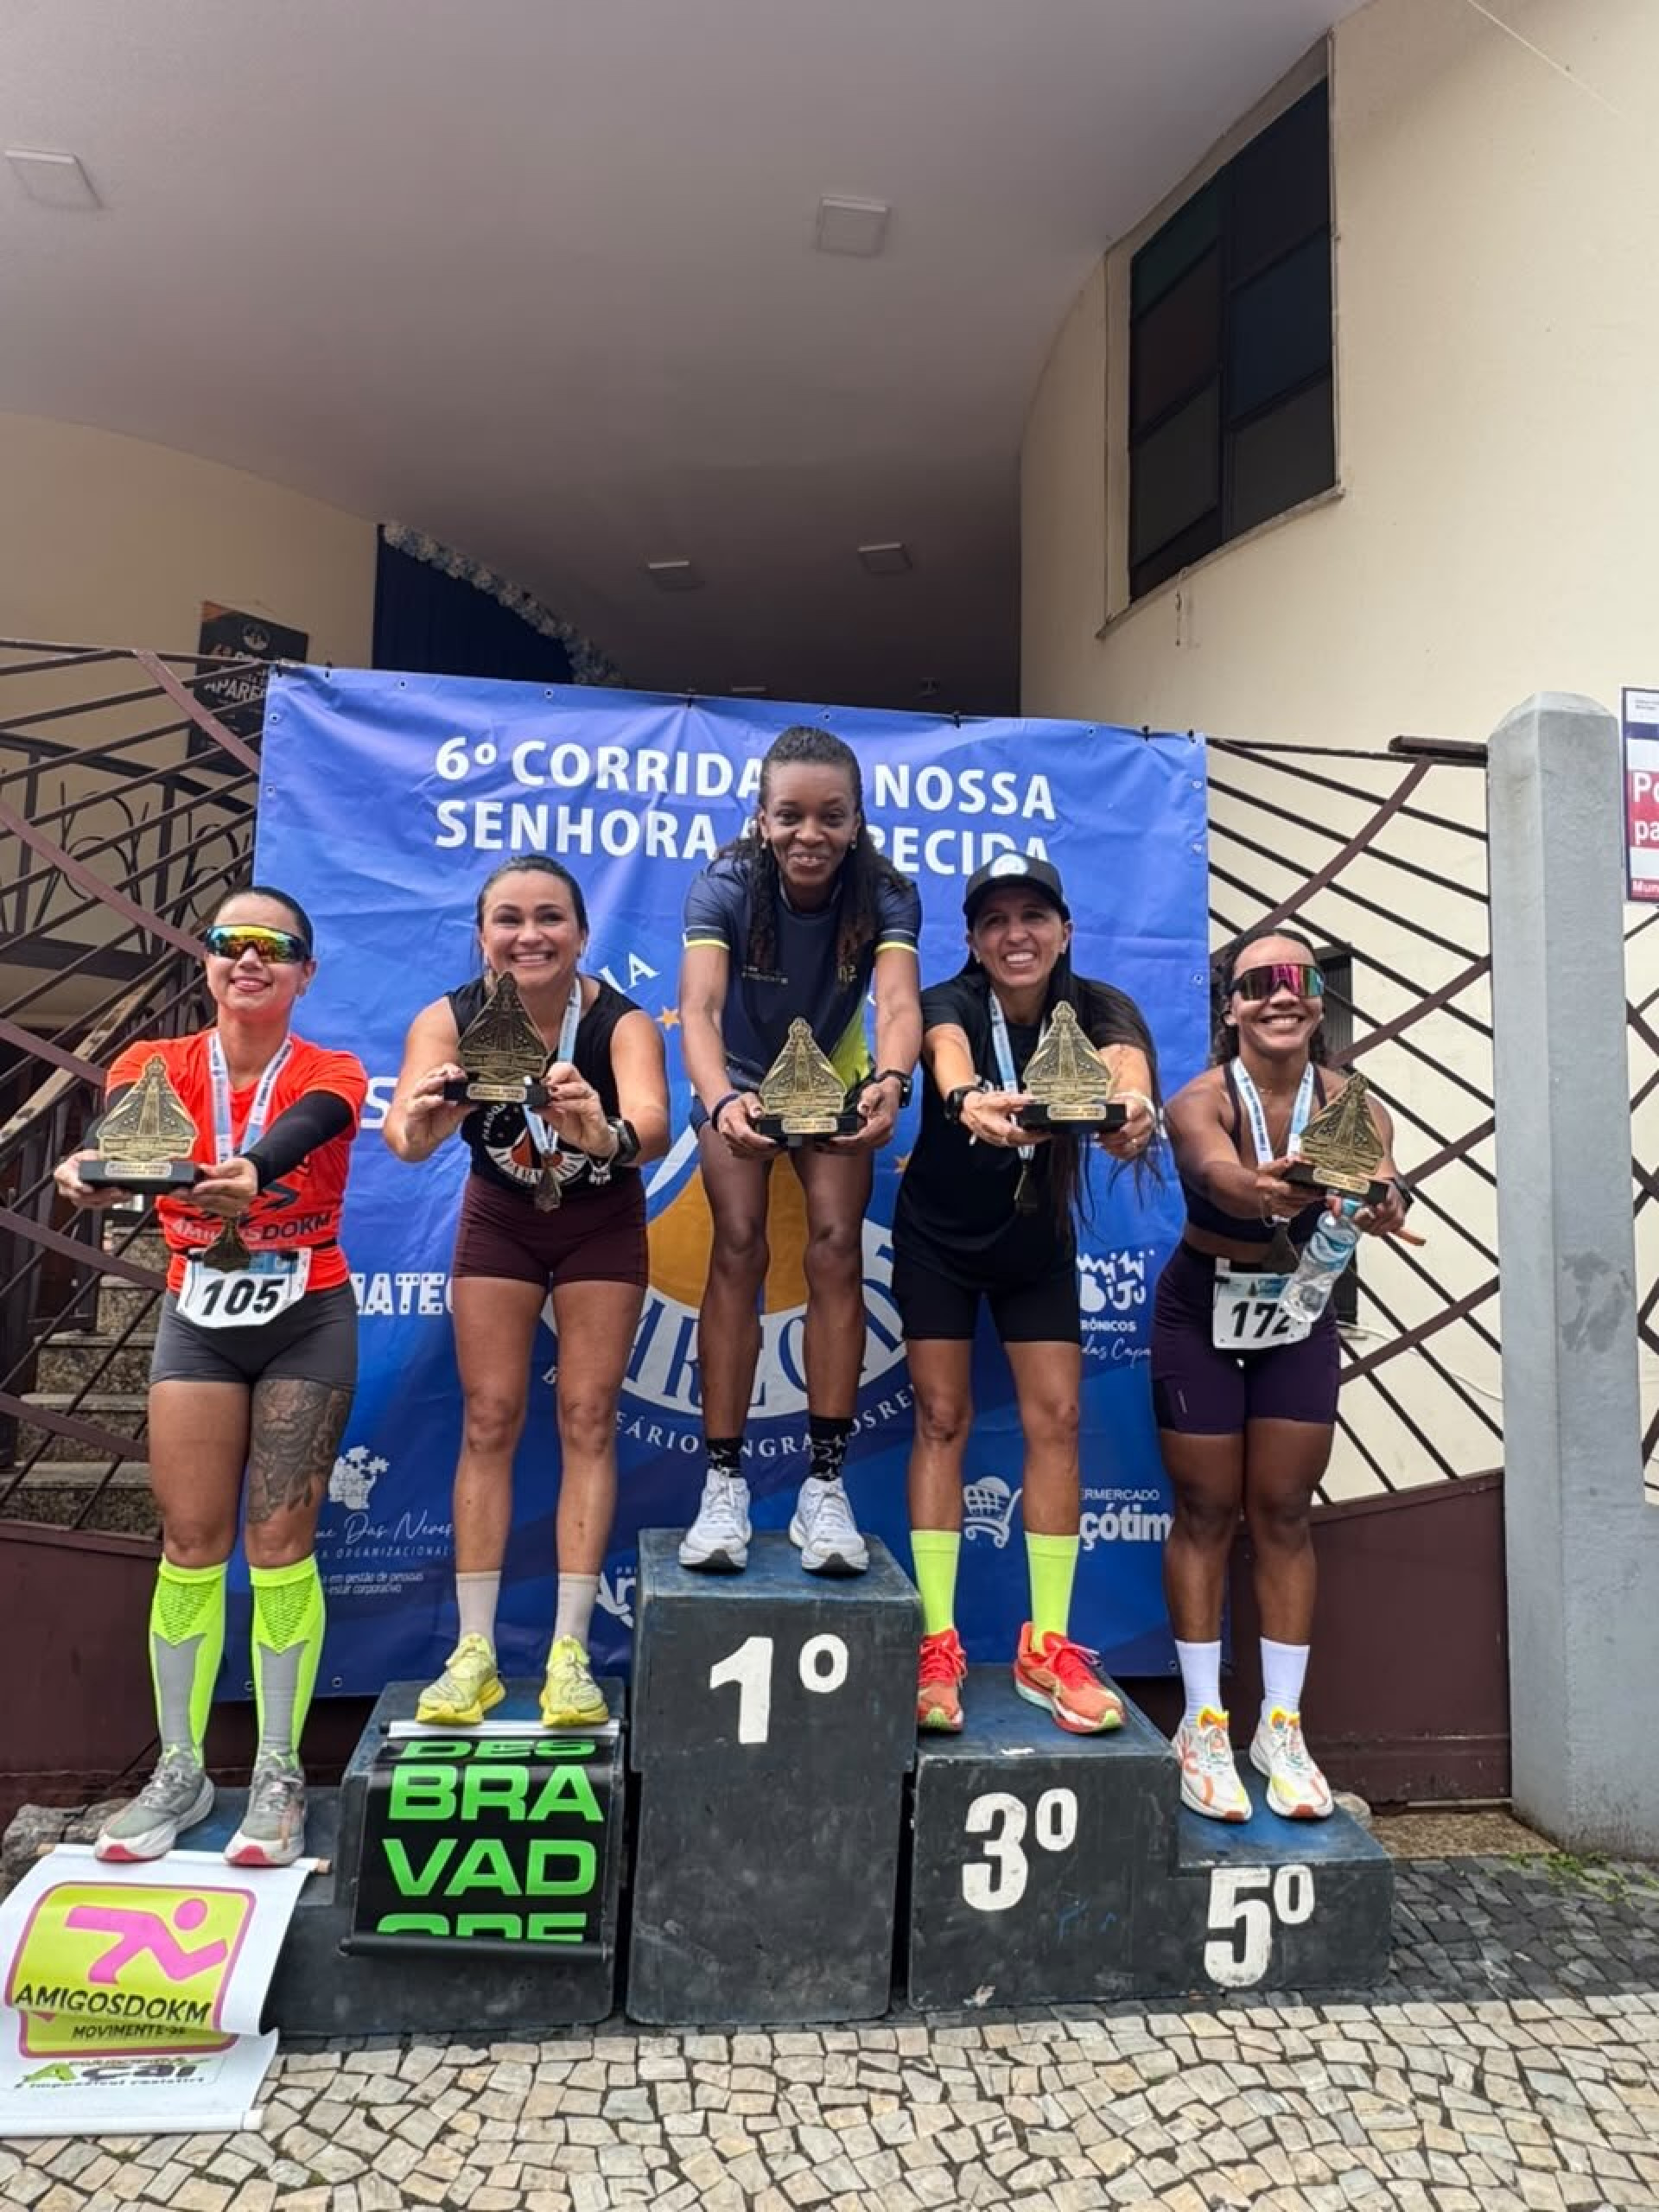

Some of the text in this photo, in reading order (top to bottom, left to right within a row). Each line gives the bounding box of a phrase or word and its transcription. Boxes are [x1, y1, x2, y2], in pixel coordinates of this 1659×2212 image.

[435, 736, 1056, 820] 6º CORRIDA NOSSA
[435, 801, 716, 860] SENHORA
[203, 1278, 286, 1316] 105
[710, 1634, 849, 1745] 1º
[389, 1764, 604, 1821] BRA
[382, 1838, 597, 1896] VAD
[963, 1788, 1078, 1911] 3º
[1204, 1865, 1315, 1987] 5º
[14, 1984, 212, 2024] AMIGOSDOKM
